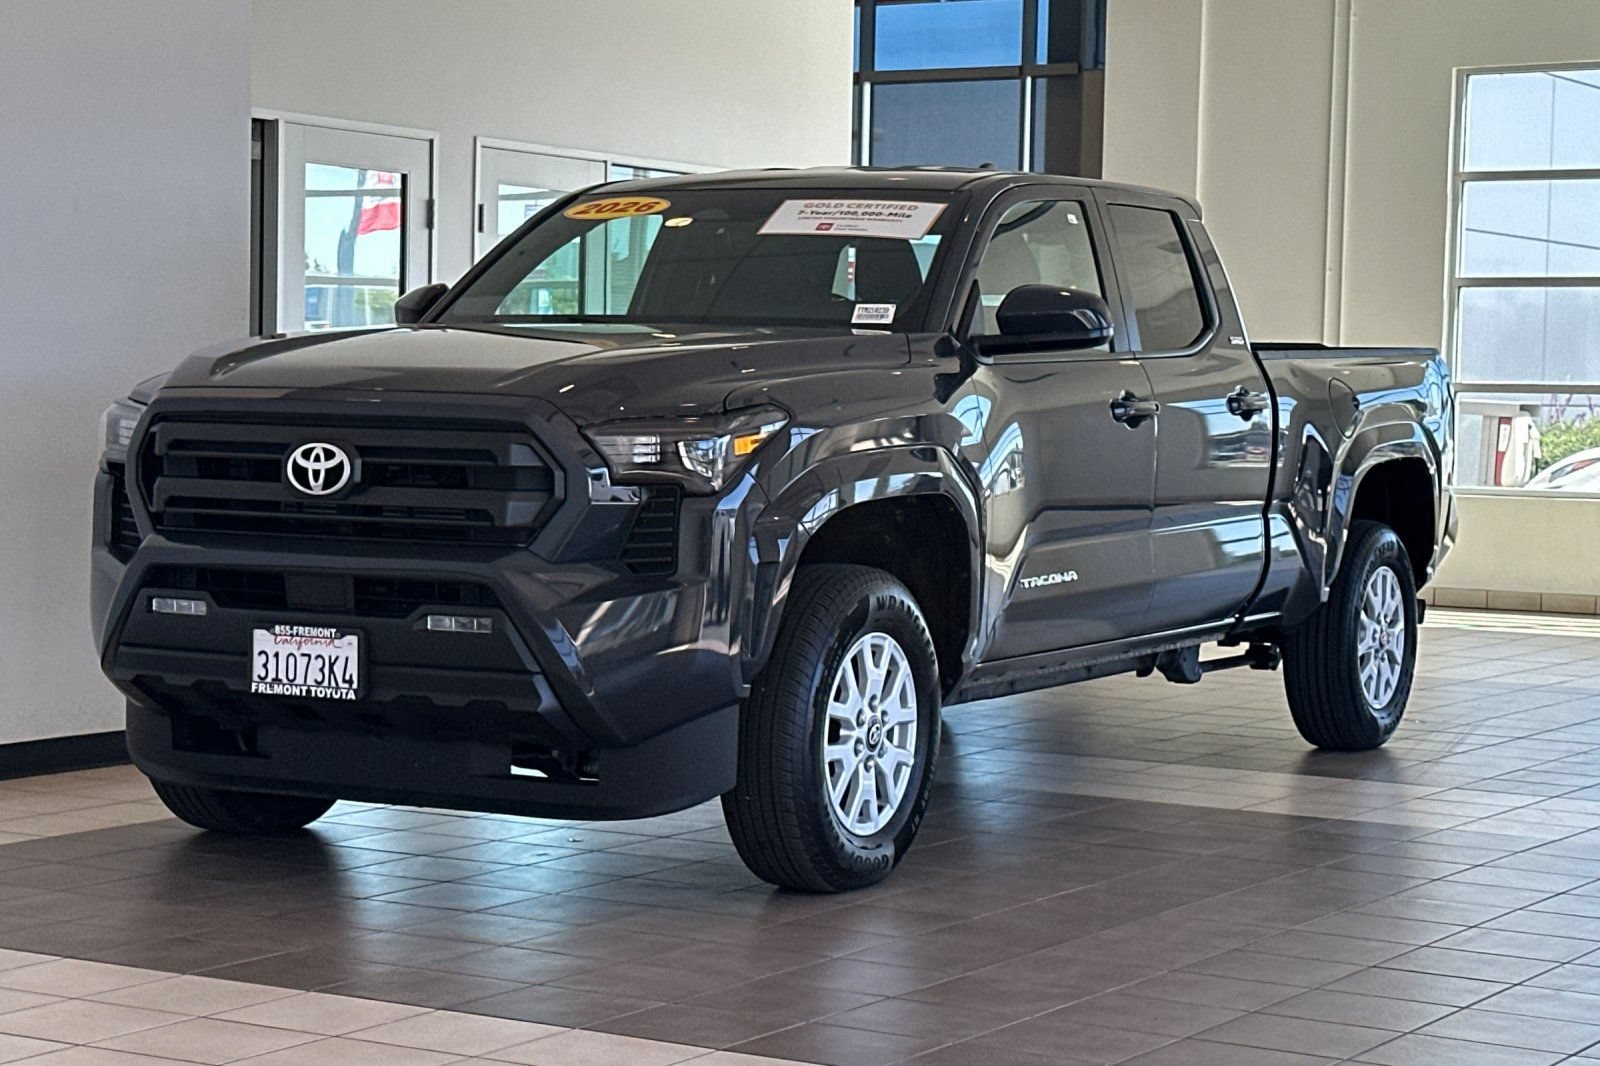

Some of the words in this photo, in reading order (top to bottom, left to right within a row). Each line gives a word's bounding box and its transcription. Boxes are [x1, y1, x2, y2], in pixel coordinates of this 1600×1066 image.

[573, 201, 661, 216] 2026
[803, 202, 845, 210] GOLD
[845, 202, 919, 211] CERTIFIED
[797, 210, 912, 219] 7-Year/100,000-Mile
[1020, 570, 1078, 589] TACOMA
[274, 624, 337, 638] 855-FREMONT
[273, 635, 343, 650] California
[256, 650, 355, 689] 31073K4
